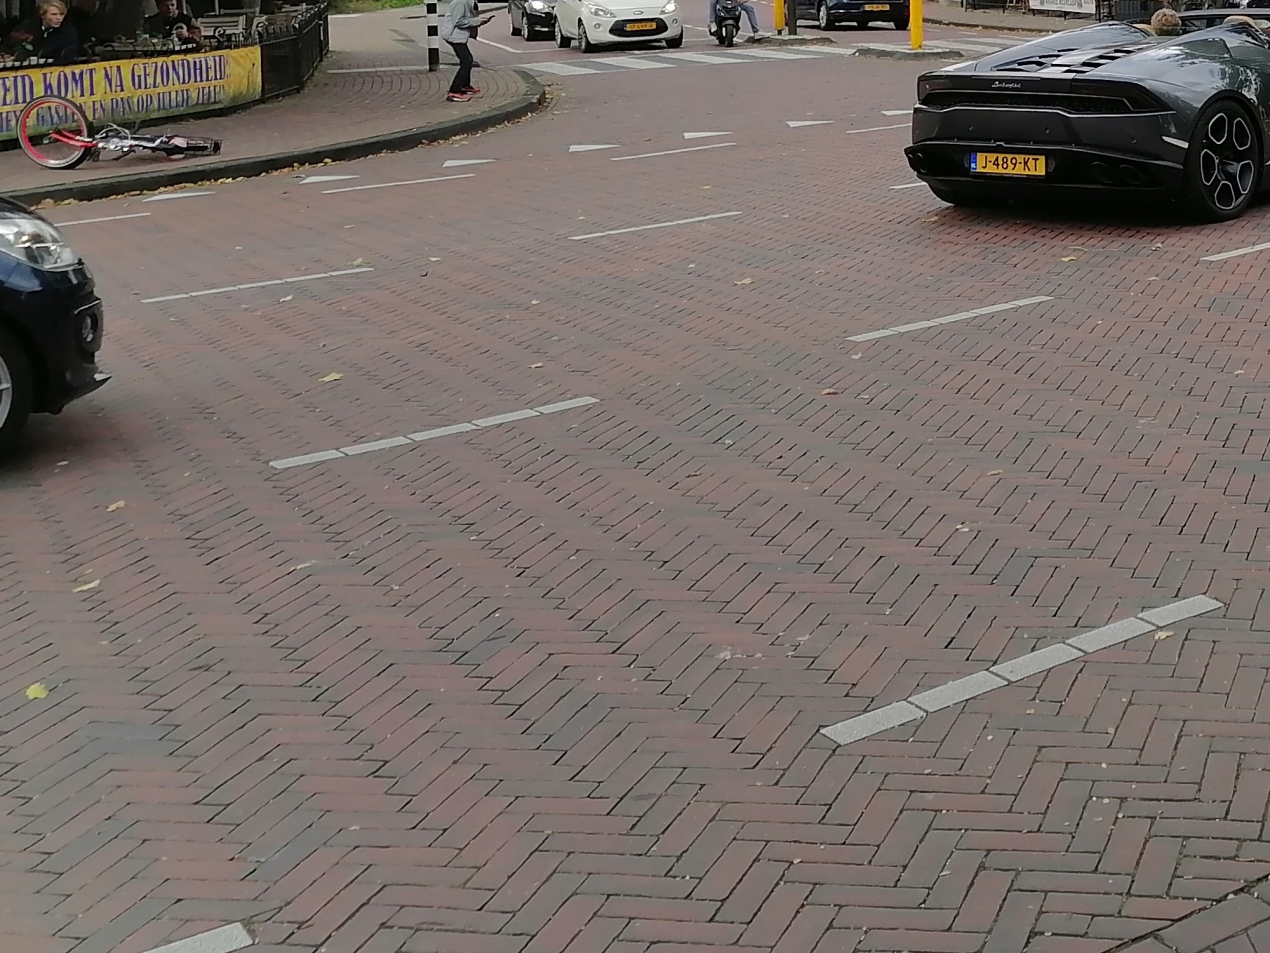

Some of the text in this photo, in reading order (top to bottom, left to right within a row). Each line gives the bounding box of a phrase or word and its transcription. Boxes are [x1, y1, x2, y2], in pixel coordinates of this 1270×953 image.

[42, 68, 96, 98] KOMT
[103, 65, 125, 94] NA
[137, 93, 153, 113] OP
[981, 155, 1040, 172] J-489-KT
